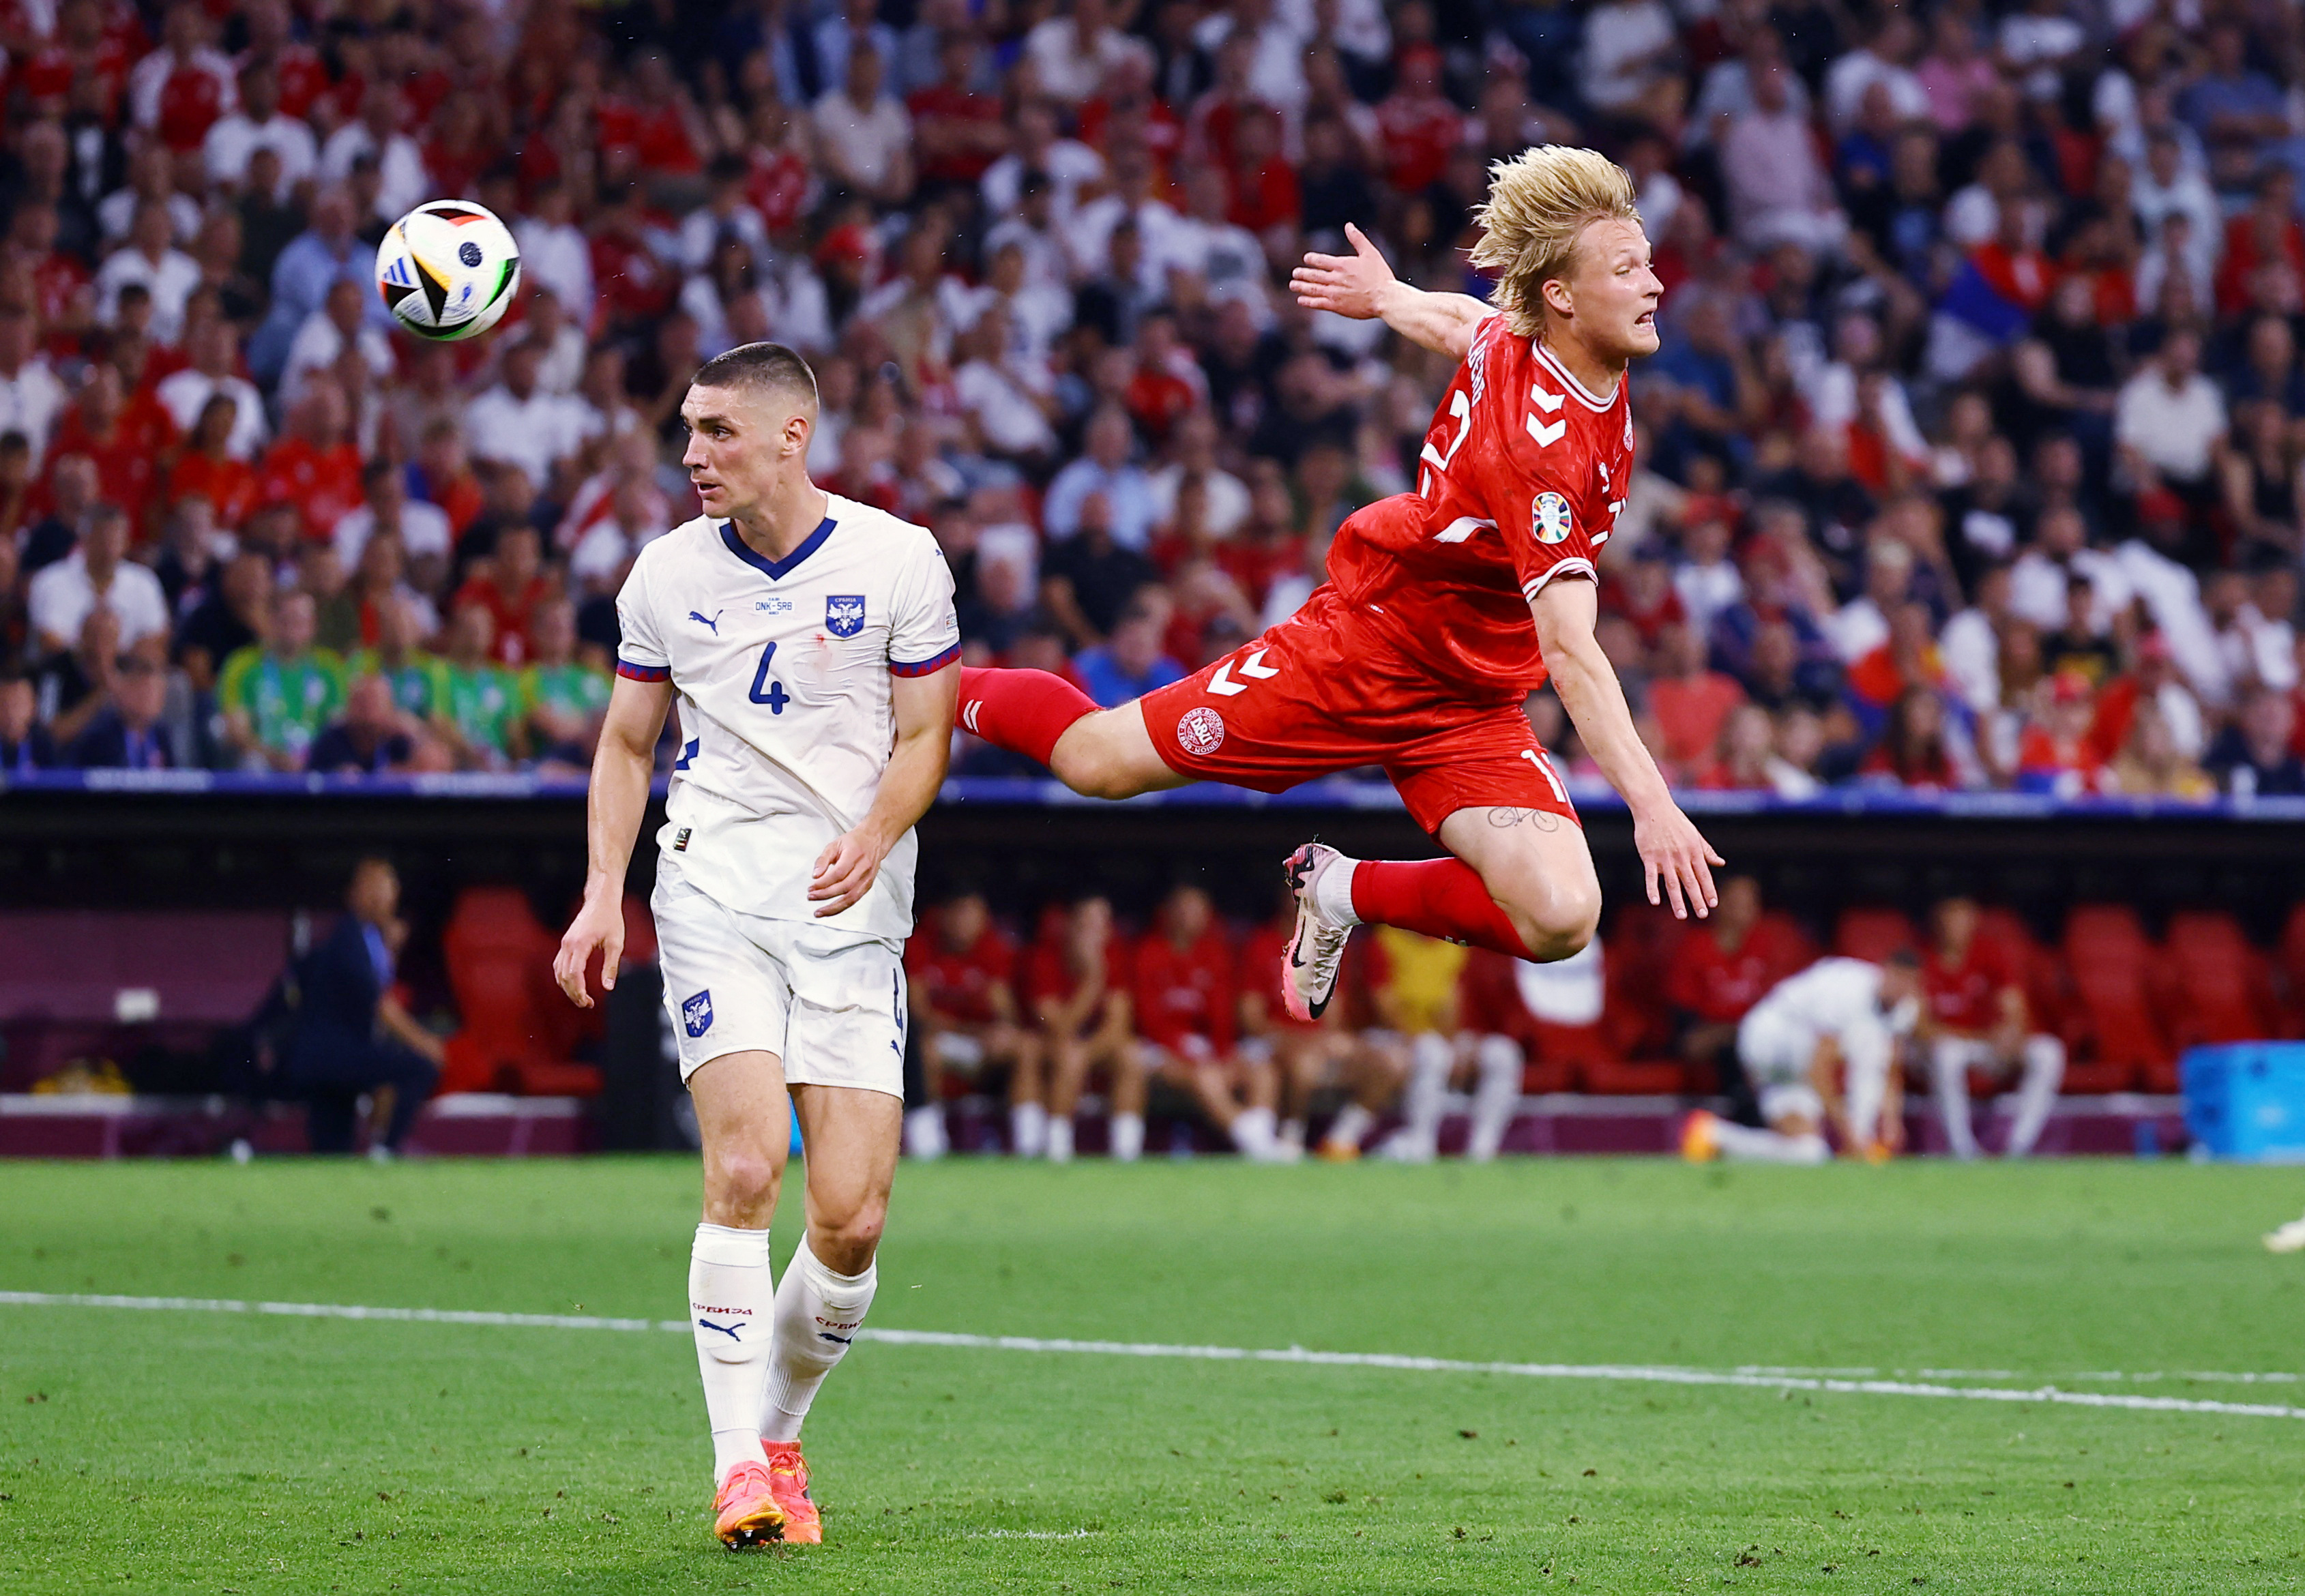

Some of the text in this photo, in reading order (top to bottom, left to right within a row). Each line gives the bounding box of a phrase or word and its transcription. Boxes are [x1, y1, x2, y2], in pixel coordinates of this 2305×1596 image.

[748, 641, 791, 715] 4
[1190, 715, 1214, 745] DBU
[1194, 741, 1219, 753] UNION
[1521, 750, 1574, 811] 1
[815, 1316, 865, 1330] СРБИ
